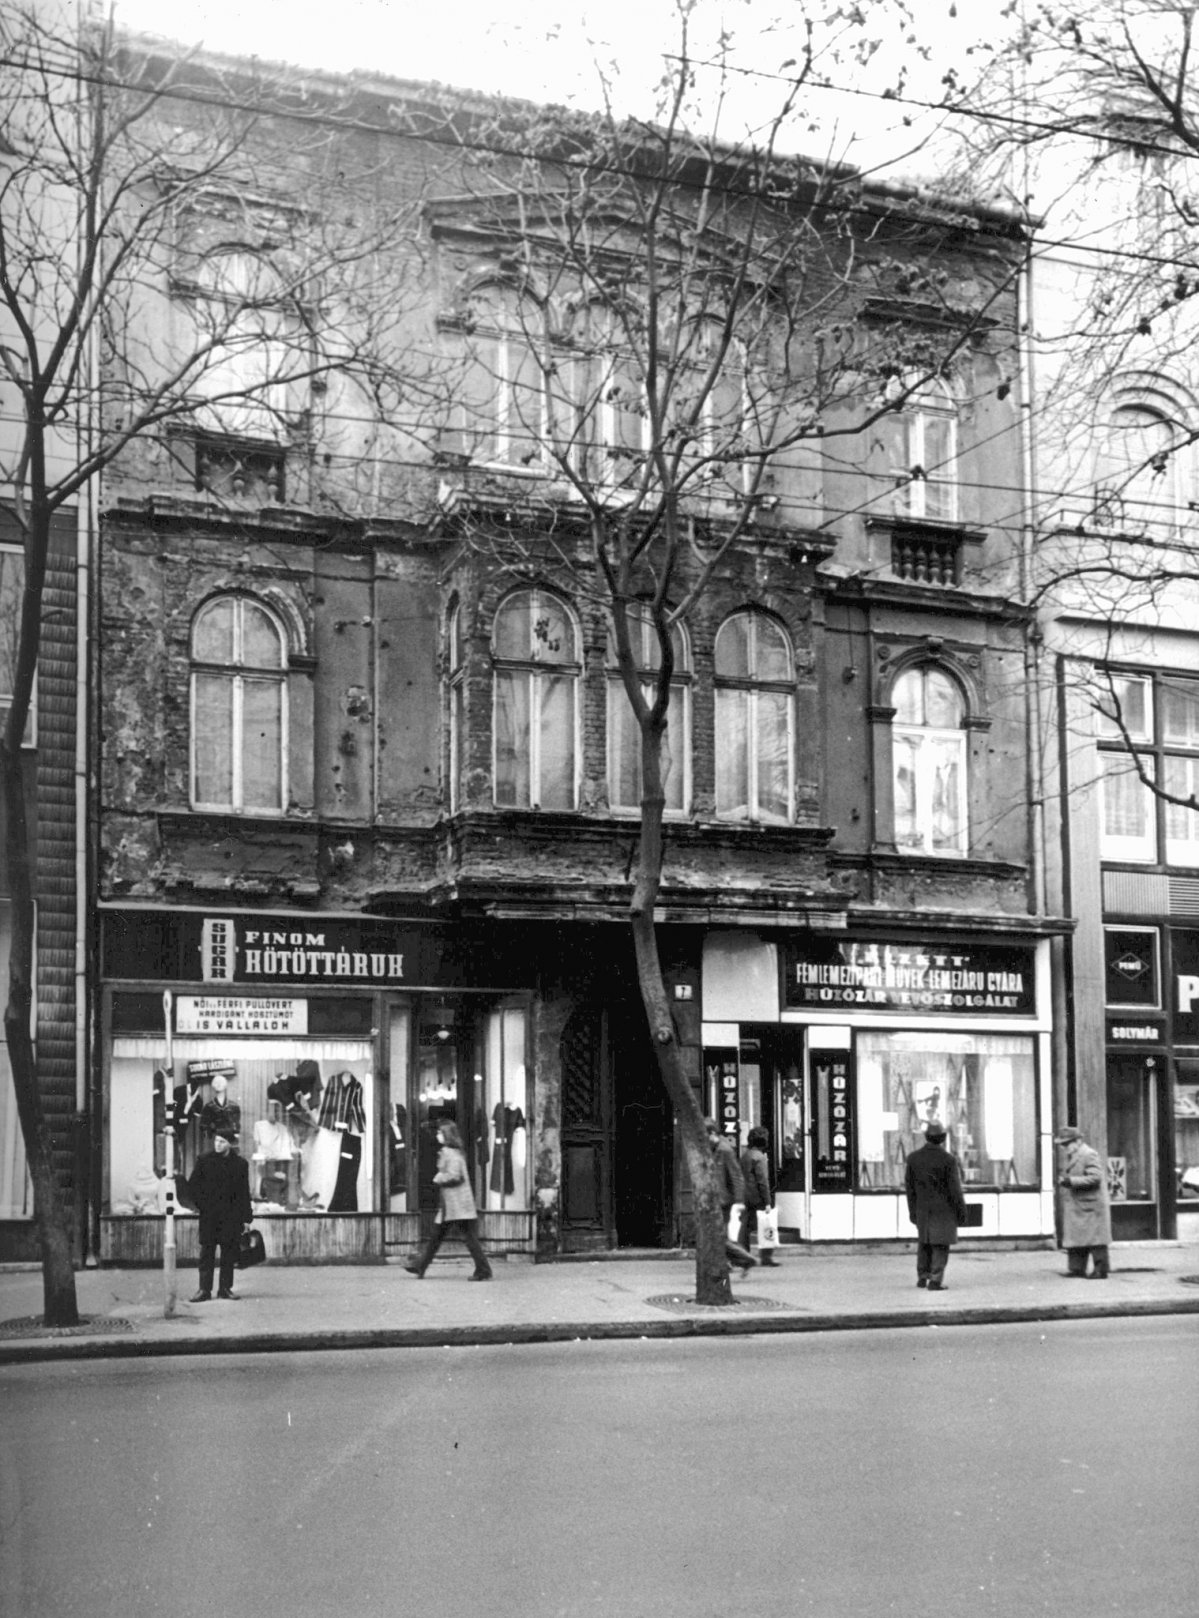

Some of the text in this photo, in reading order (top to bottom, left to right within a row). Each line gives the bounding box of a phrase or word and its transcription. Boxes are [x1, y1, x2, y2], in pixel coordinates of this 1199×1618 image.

[245, 931, 325, 946] FINOM
[245, 946, 404, 977] KÖTÖTTÁRUK
[196, 1020, 209, 1030] IS
[1112, 1026, 1159, 1040] SOLYMÁR
